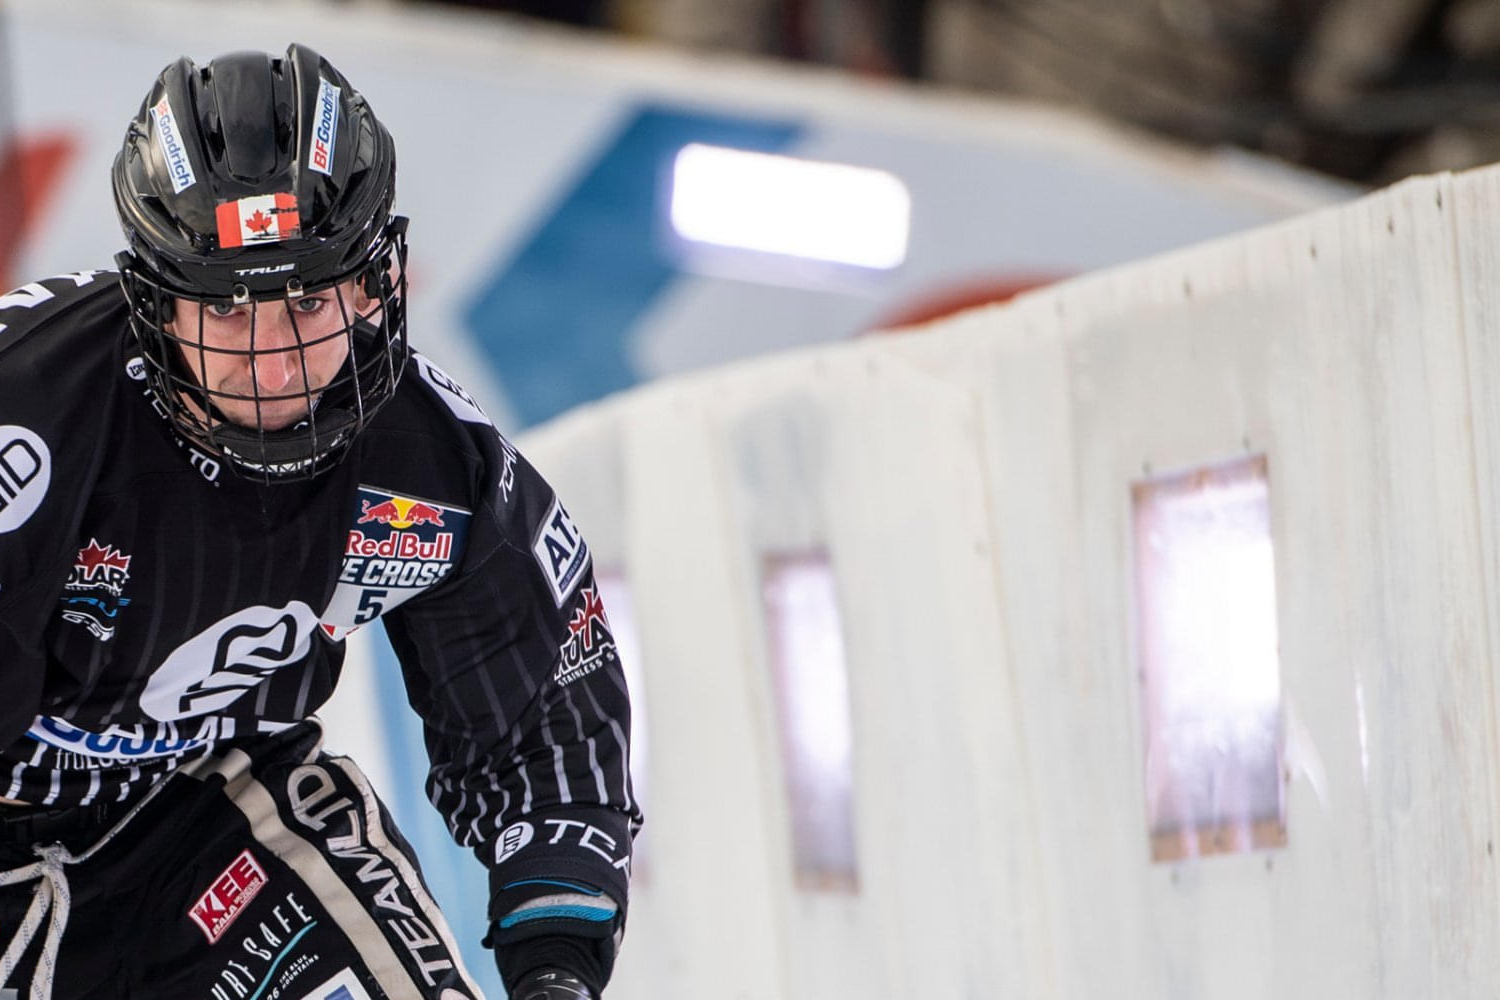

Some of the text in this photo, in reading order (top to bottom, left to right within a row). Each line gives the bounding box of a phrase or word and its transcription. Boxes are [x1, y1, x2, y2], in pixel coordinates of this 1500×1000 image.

[234, 262, 296, 277] TRUE
[345, 530, 453, 561] Red Bull
[194, 856, 257, 929] KEE
[286, 763, 454, 988] TEAMLTD
[242, 891, 313, 962] SAFE
